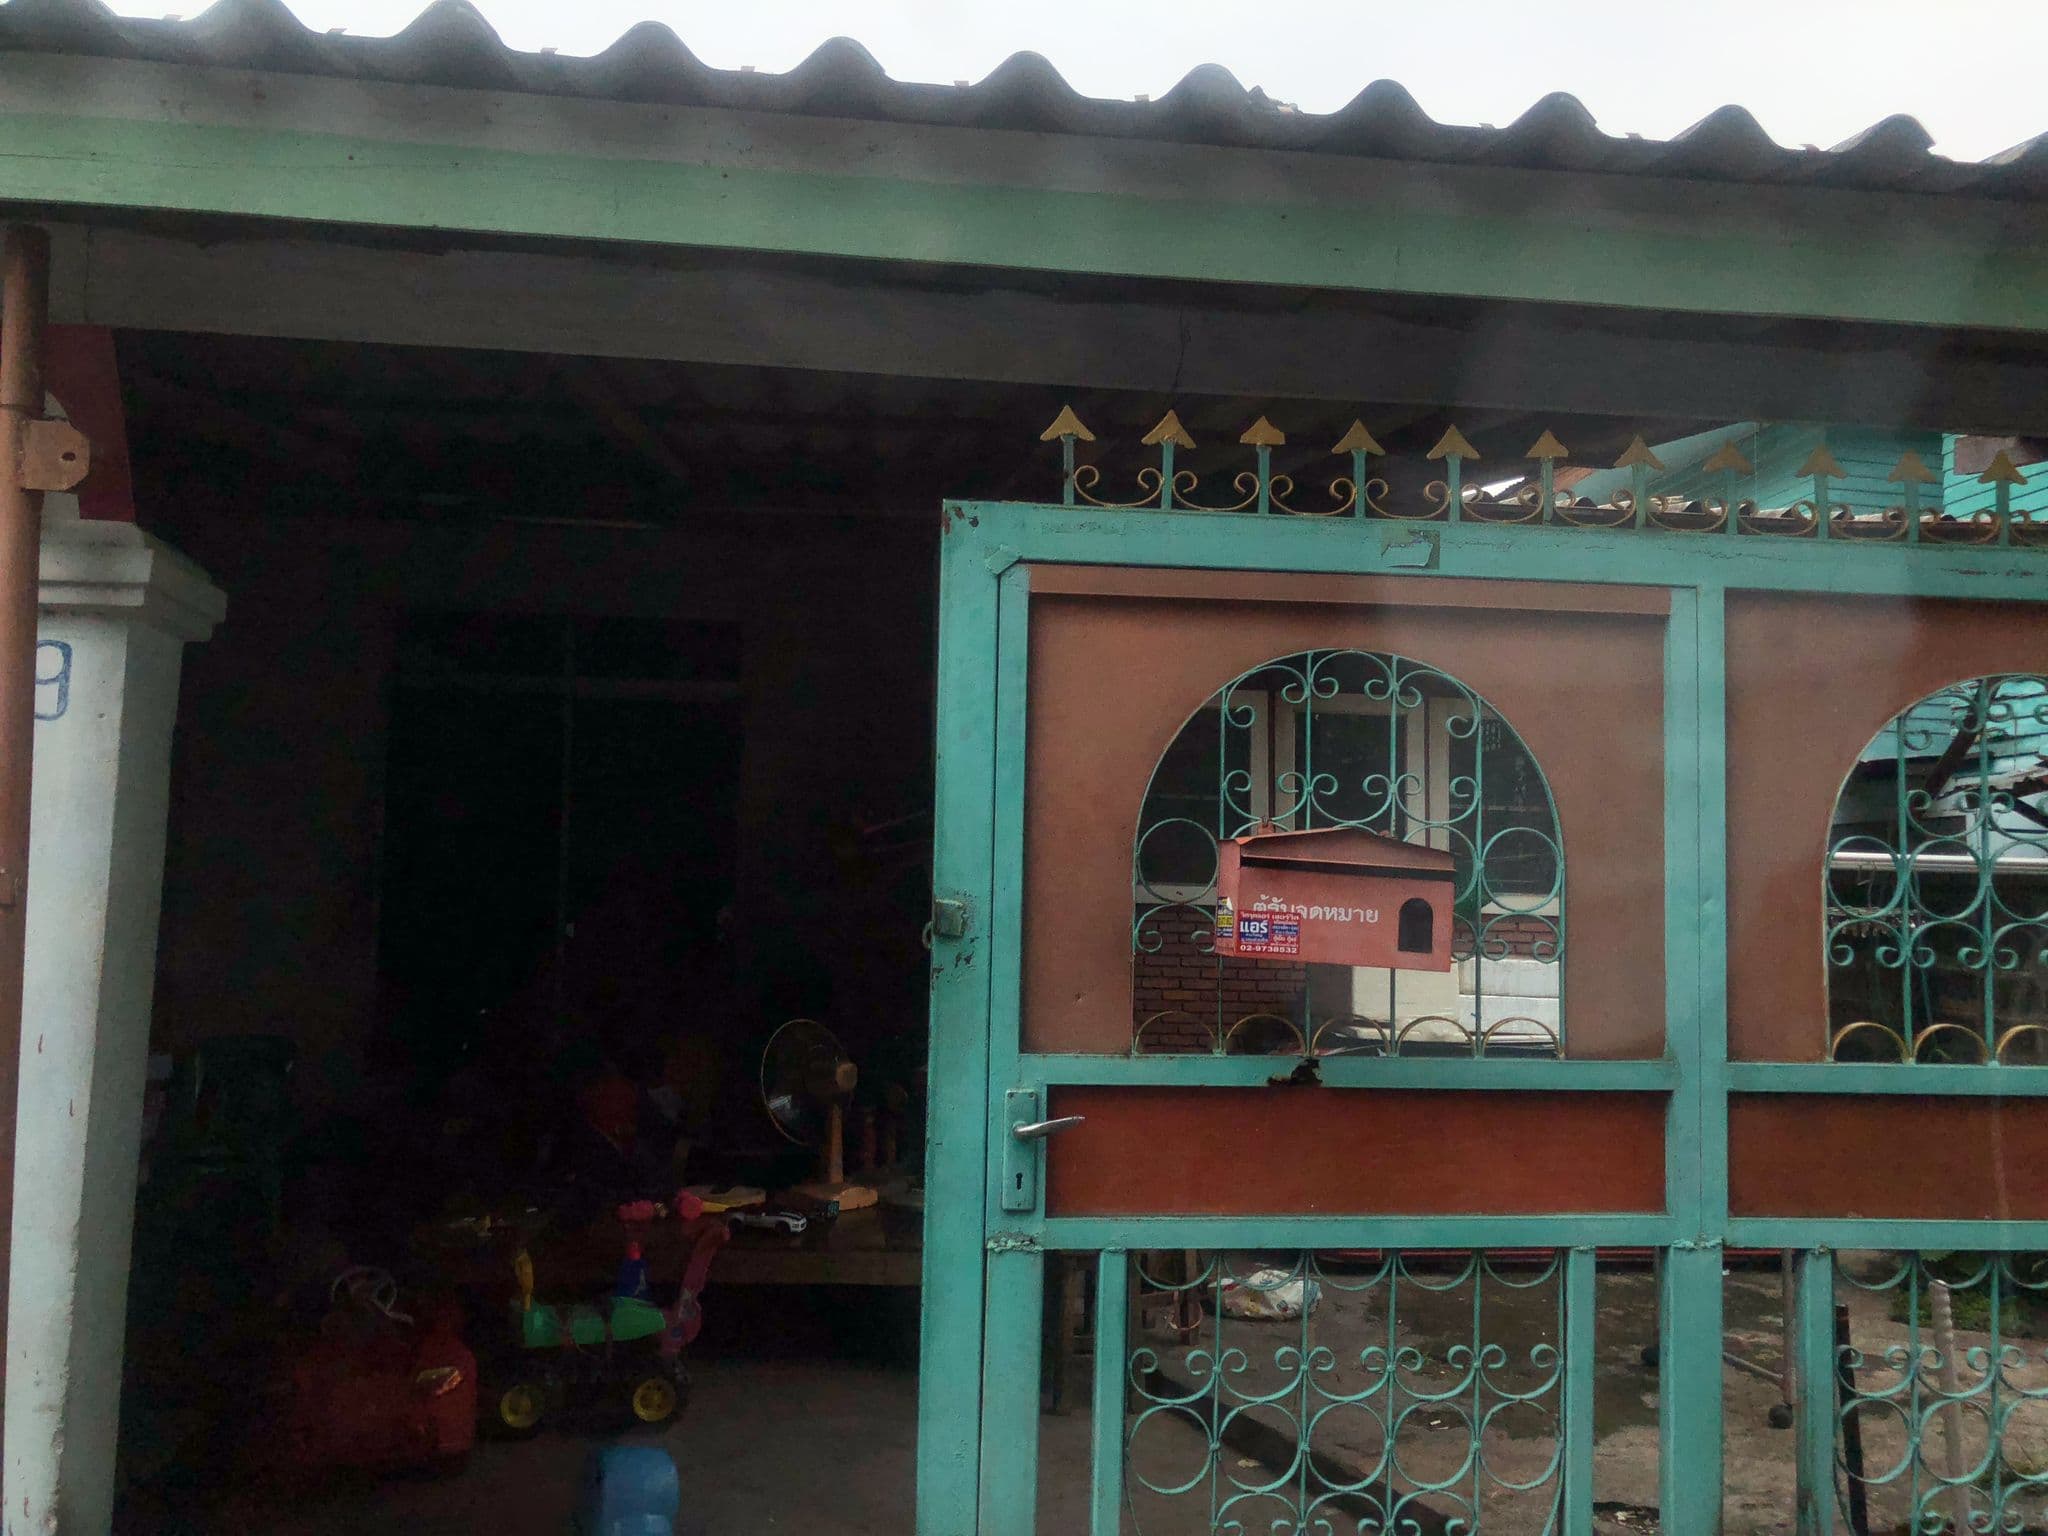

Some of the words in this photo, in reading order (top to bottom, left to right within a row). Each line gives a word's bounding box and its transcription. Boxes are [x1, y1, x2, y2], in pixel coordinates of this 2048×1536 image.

[1253, 894, 1379, 923] ต้รับจดหมาย
[1239, 919, 1269, 933] แอร์
